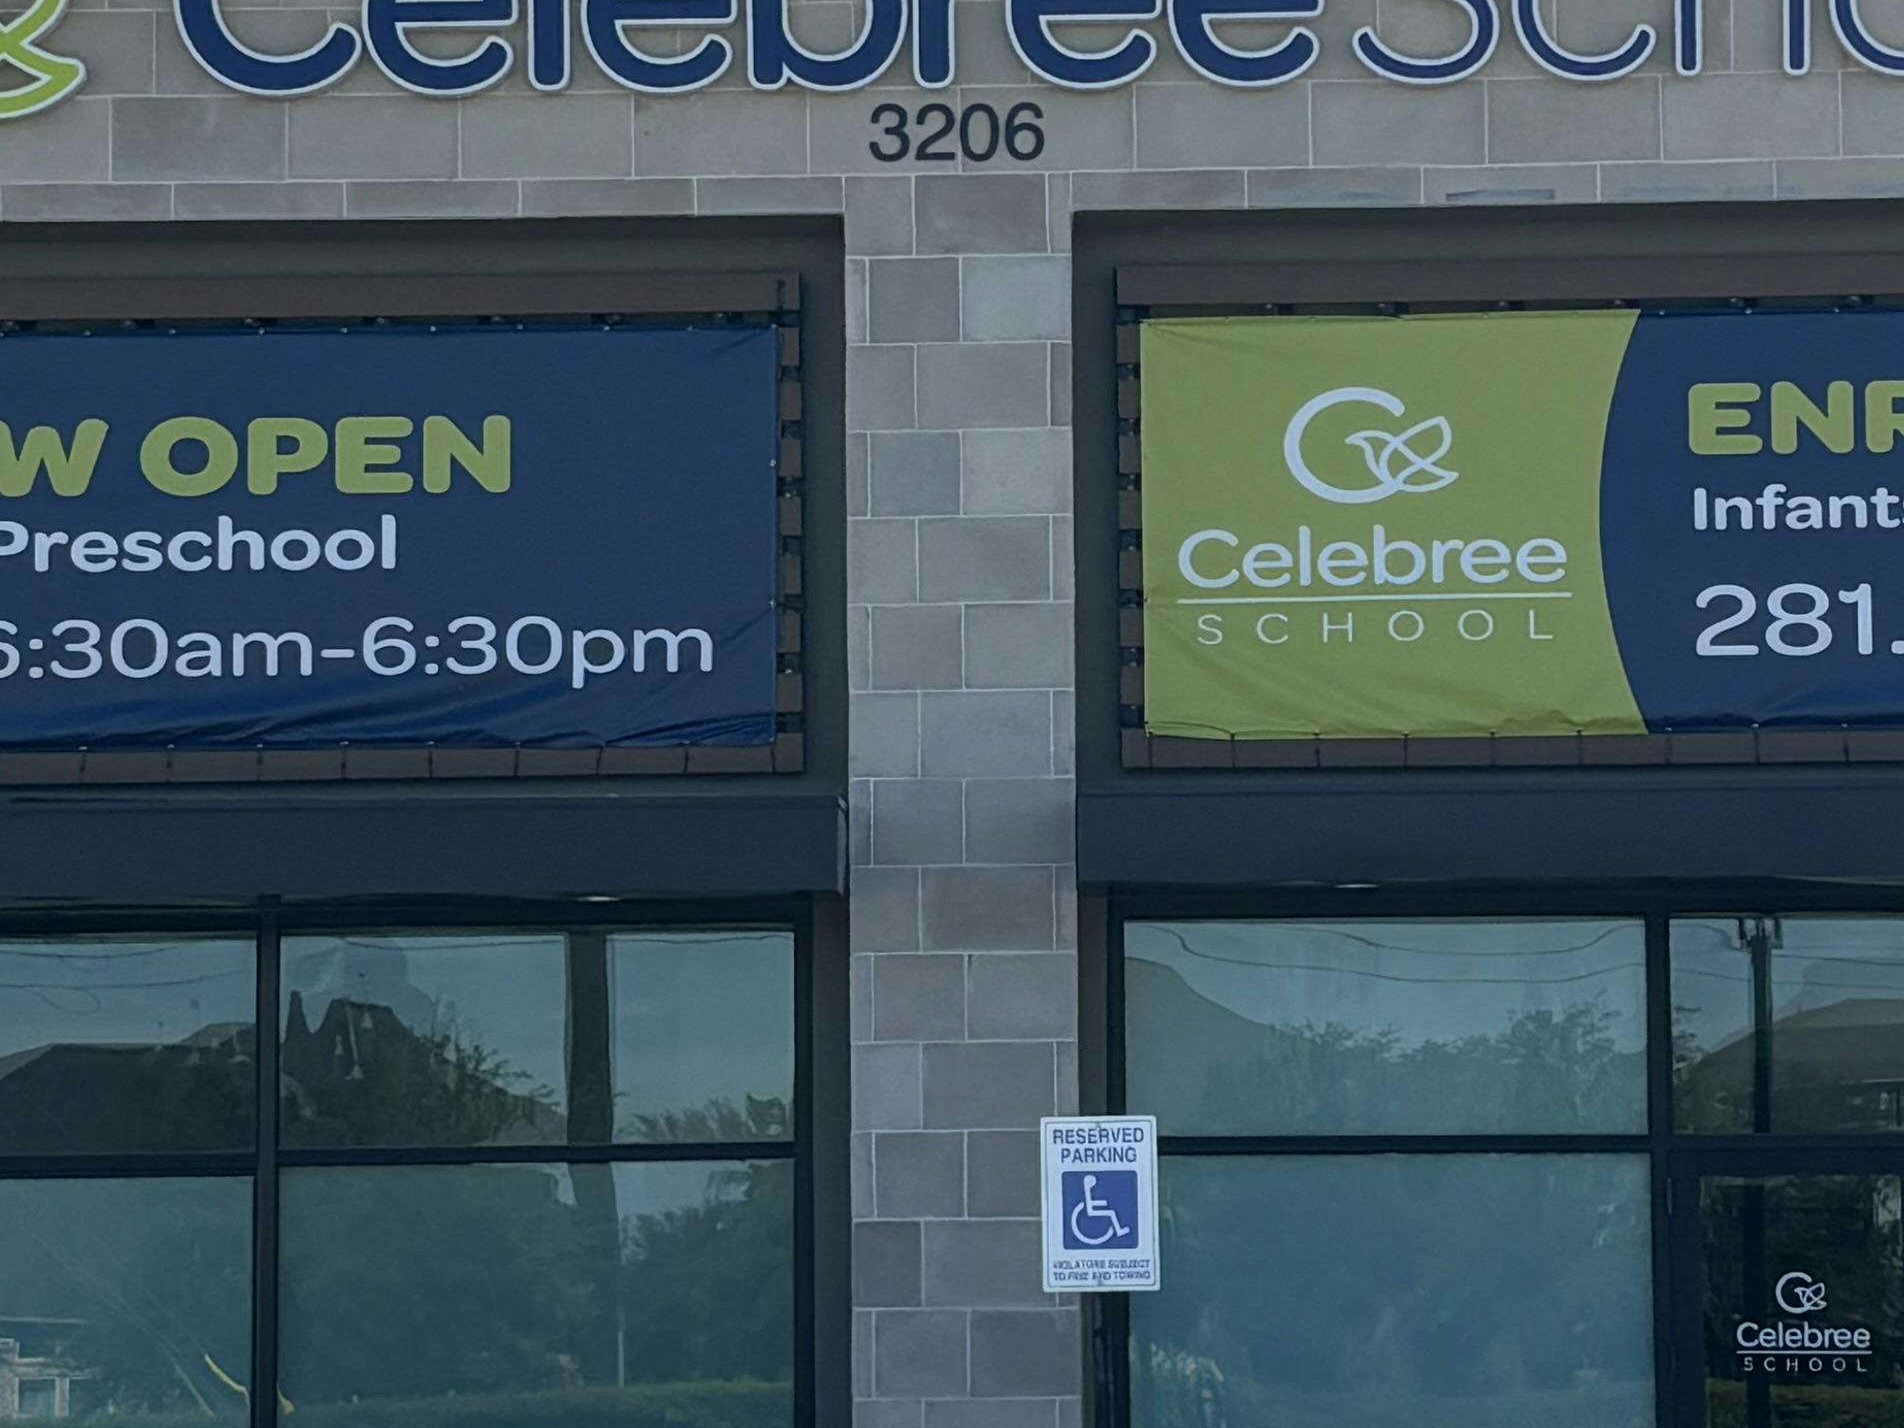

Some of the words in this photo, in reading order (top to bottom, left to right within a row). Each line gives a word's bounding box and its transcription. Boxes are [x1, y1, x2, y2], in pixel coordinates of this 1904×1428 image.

[868, 101, 1046, 163] 3206
[139, 414, 511, 497] OPEN
[1177, 524, 1568, 589] Celebree
[1197, 609, 1554, 645] SCHOOL
[1053, 1127, 1144, 1145] RESERVED
[1061, 1146, 1137, 1163] PARKING
[1736, 1321, 1871, 1349] Celebree
[1743, 1356, 1868, 1372] SCHOOL
